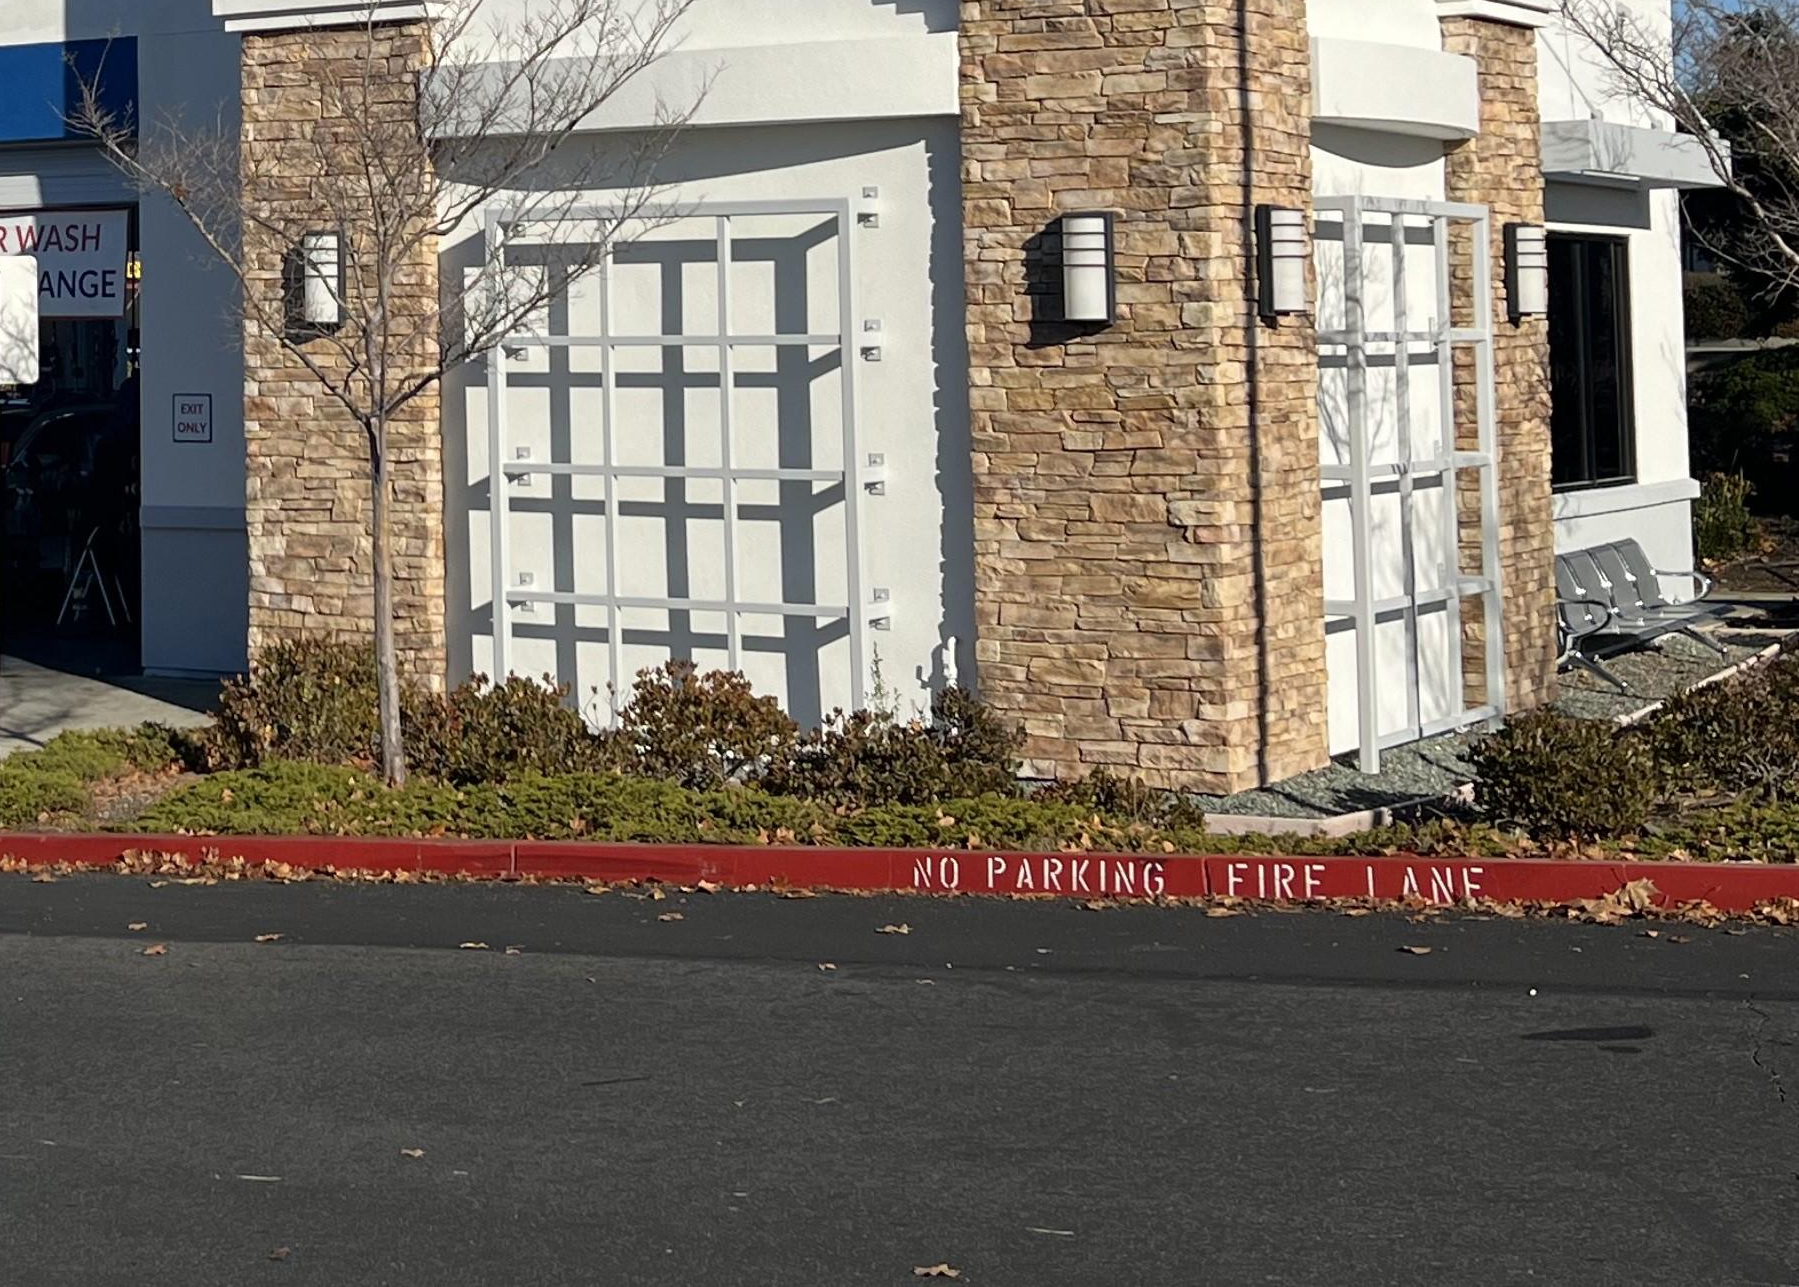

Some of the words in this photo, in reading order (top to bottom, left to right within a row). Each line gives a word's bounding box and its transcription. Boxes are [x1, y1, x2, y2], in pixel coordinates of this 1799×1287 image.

[15, 223, 101, 253] WASH
[38, 269, 116, 298] ANGE
[181, 403, 203, 414] EXIT
[177, 422, 208, 433] ONLY
[913, 856, 960, 890] NO
[986, 856, 1166, 896] PARKING
[1228, 863, 1326, 899] FIRE
